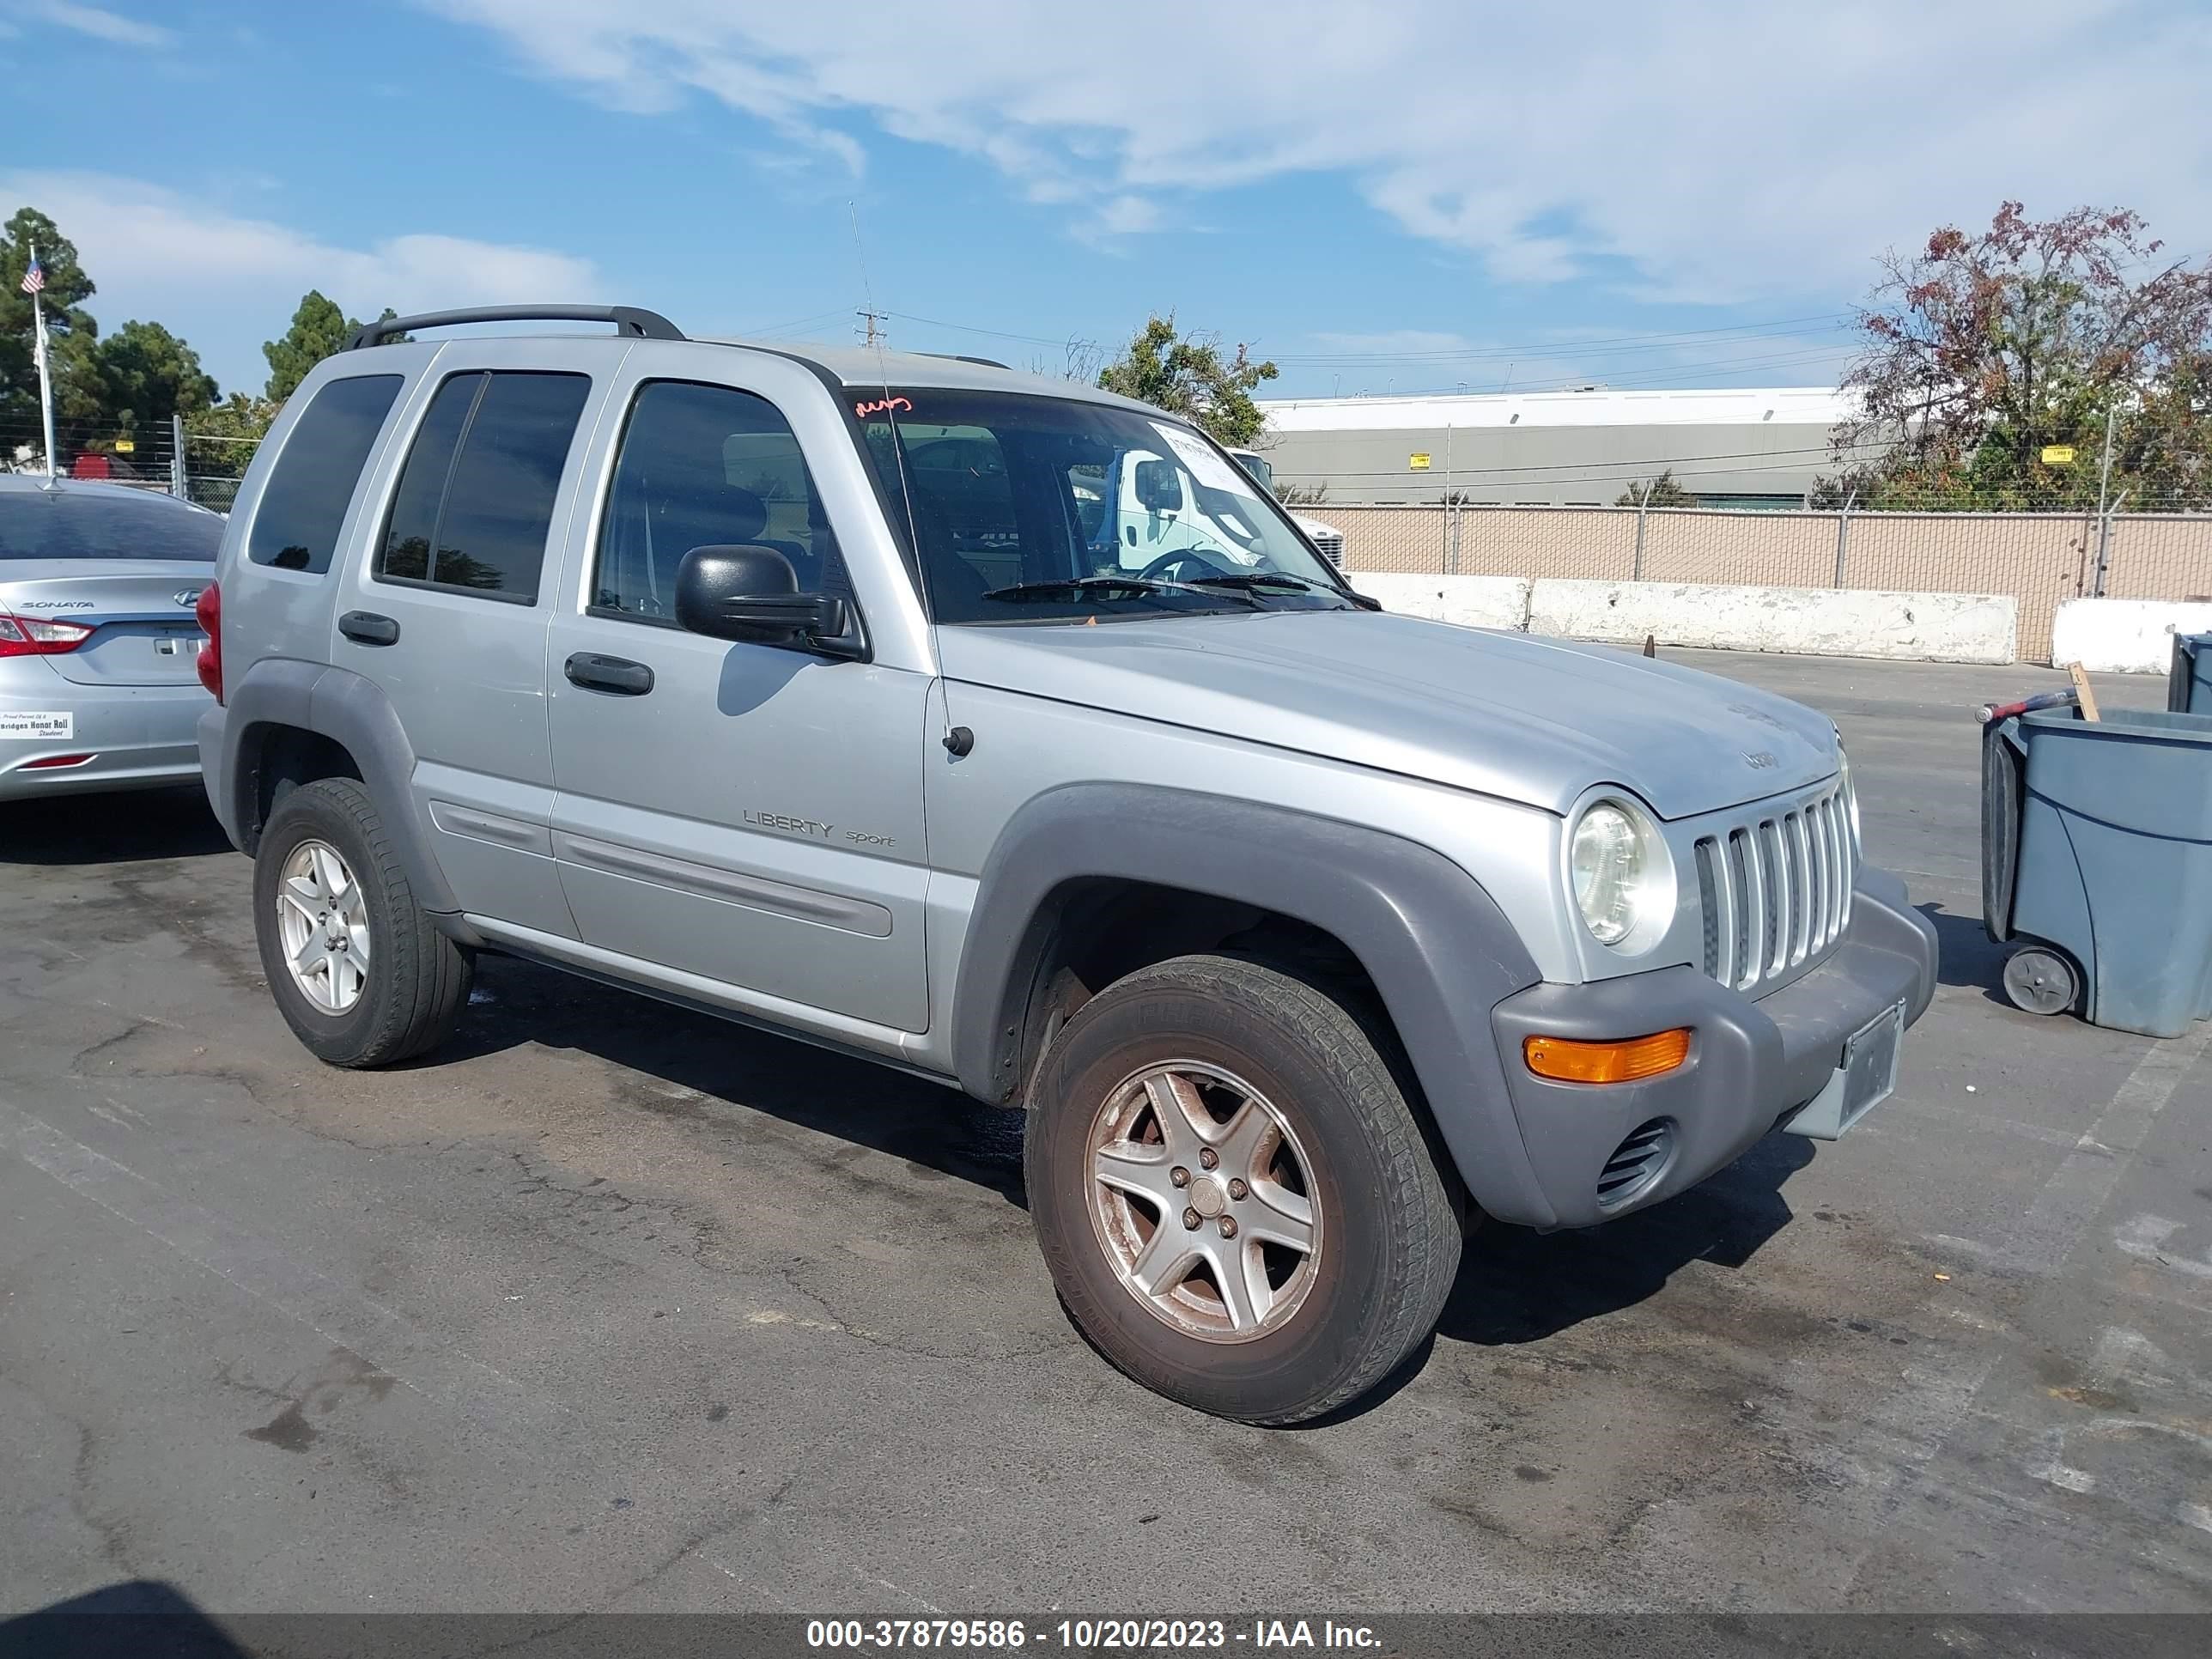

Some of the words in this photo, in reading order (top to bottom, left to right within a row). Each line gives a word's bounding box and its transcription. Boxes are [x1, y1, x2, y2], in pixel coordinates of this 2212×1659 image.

[30, 720, 52, 729] Honor
[53, 718, 68, 729] Roll
[743, 809, 835, 838] LIBERTY
[845, 830, 897, 848] sport
